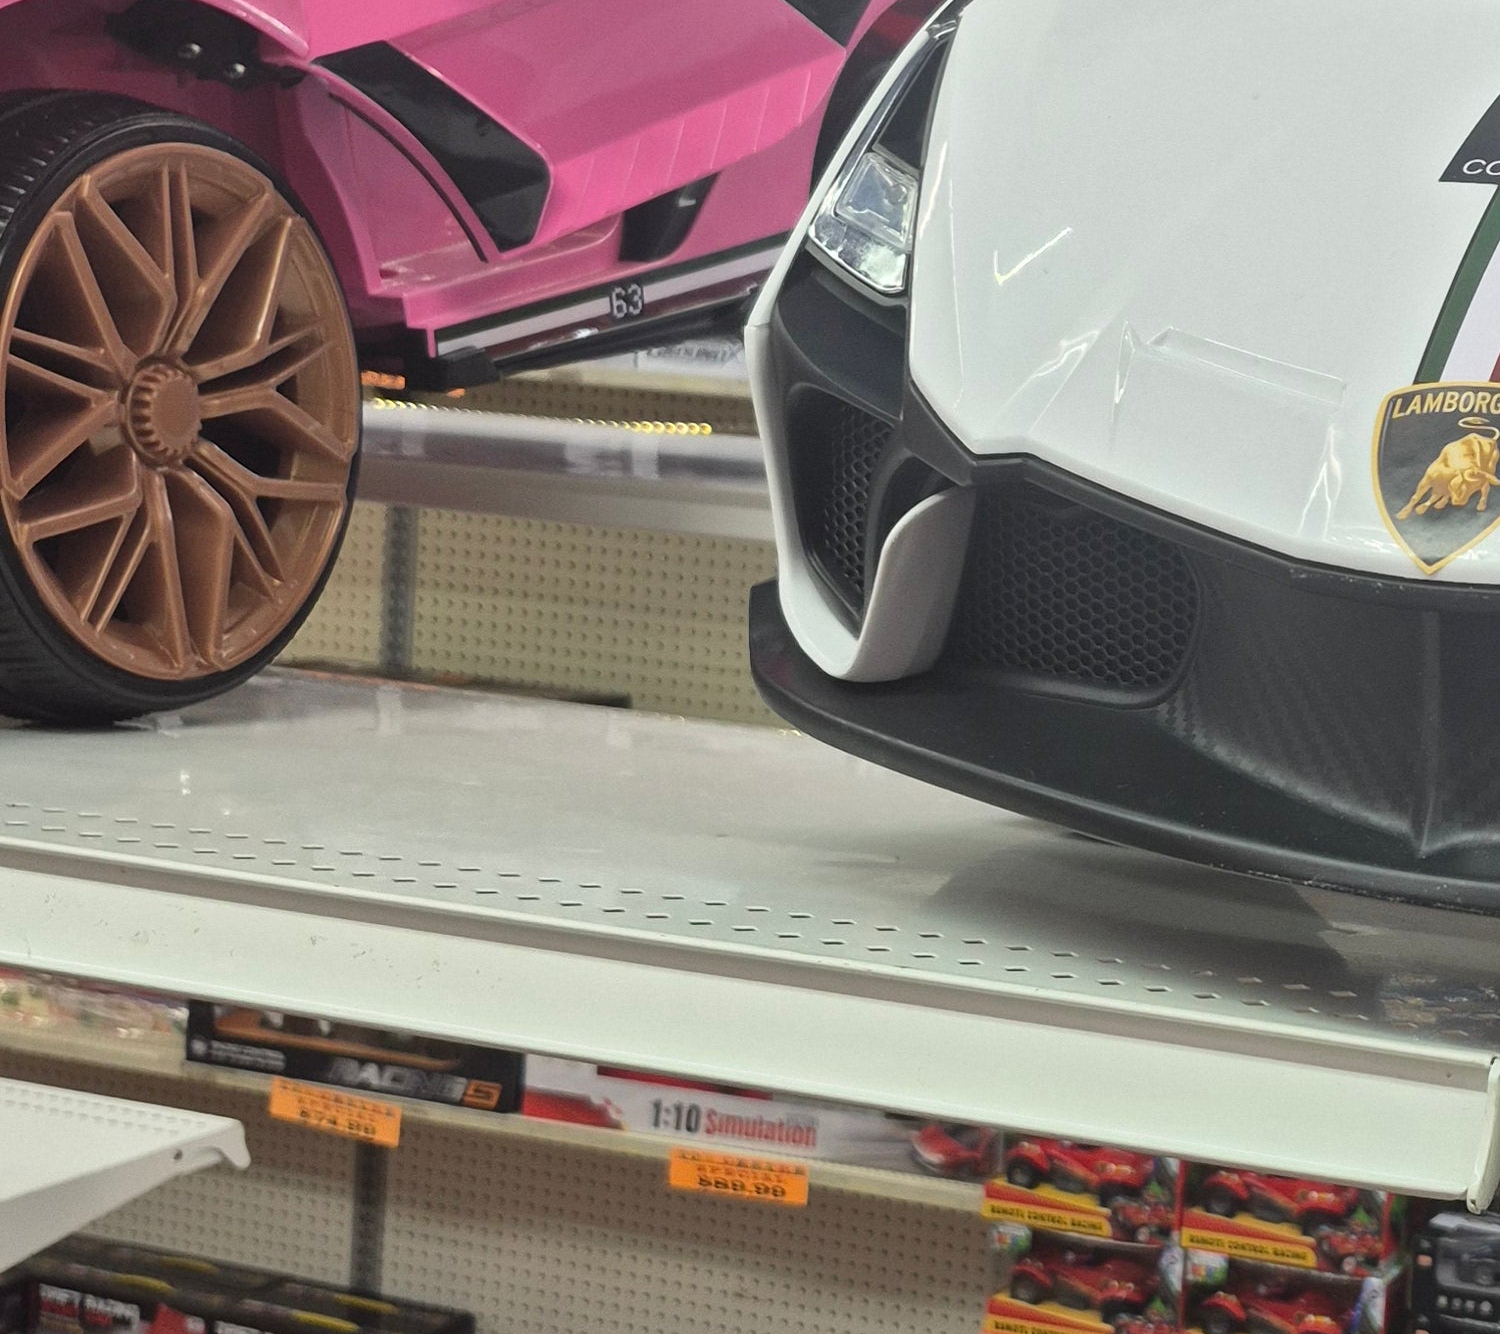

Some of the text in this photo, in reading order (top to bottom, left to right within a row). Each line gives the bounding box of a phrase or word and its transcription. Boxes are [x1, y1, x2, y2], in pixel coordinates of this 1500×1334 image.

[611, 283, 644, 318] 63
[652, 1098, 818, 1150] 1:10 Simulation
